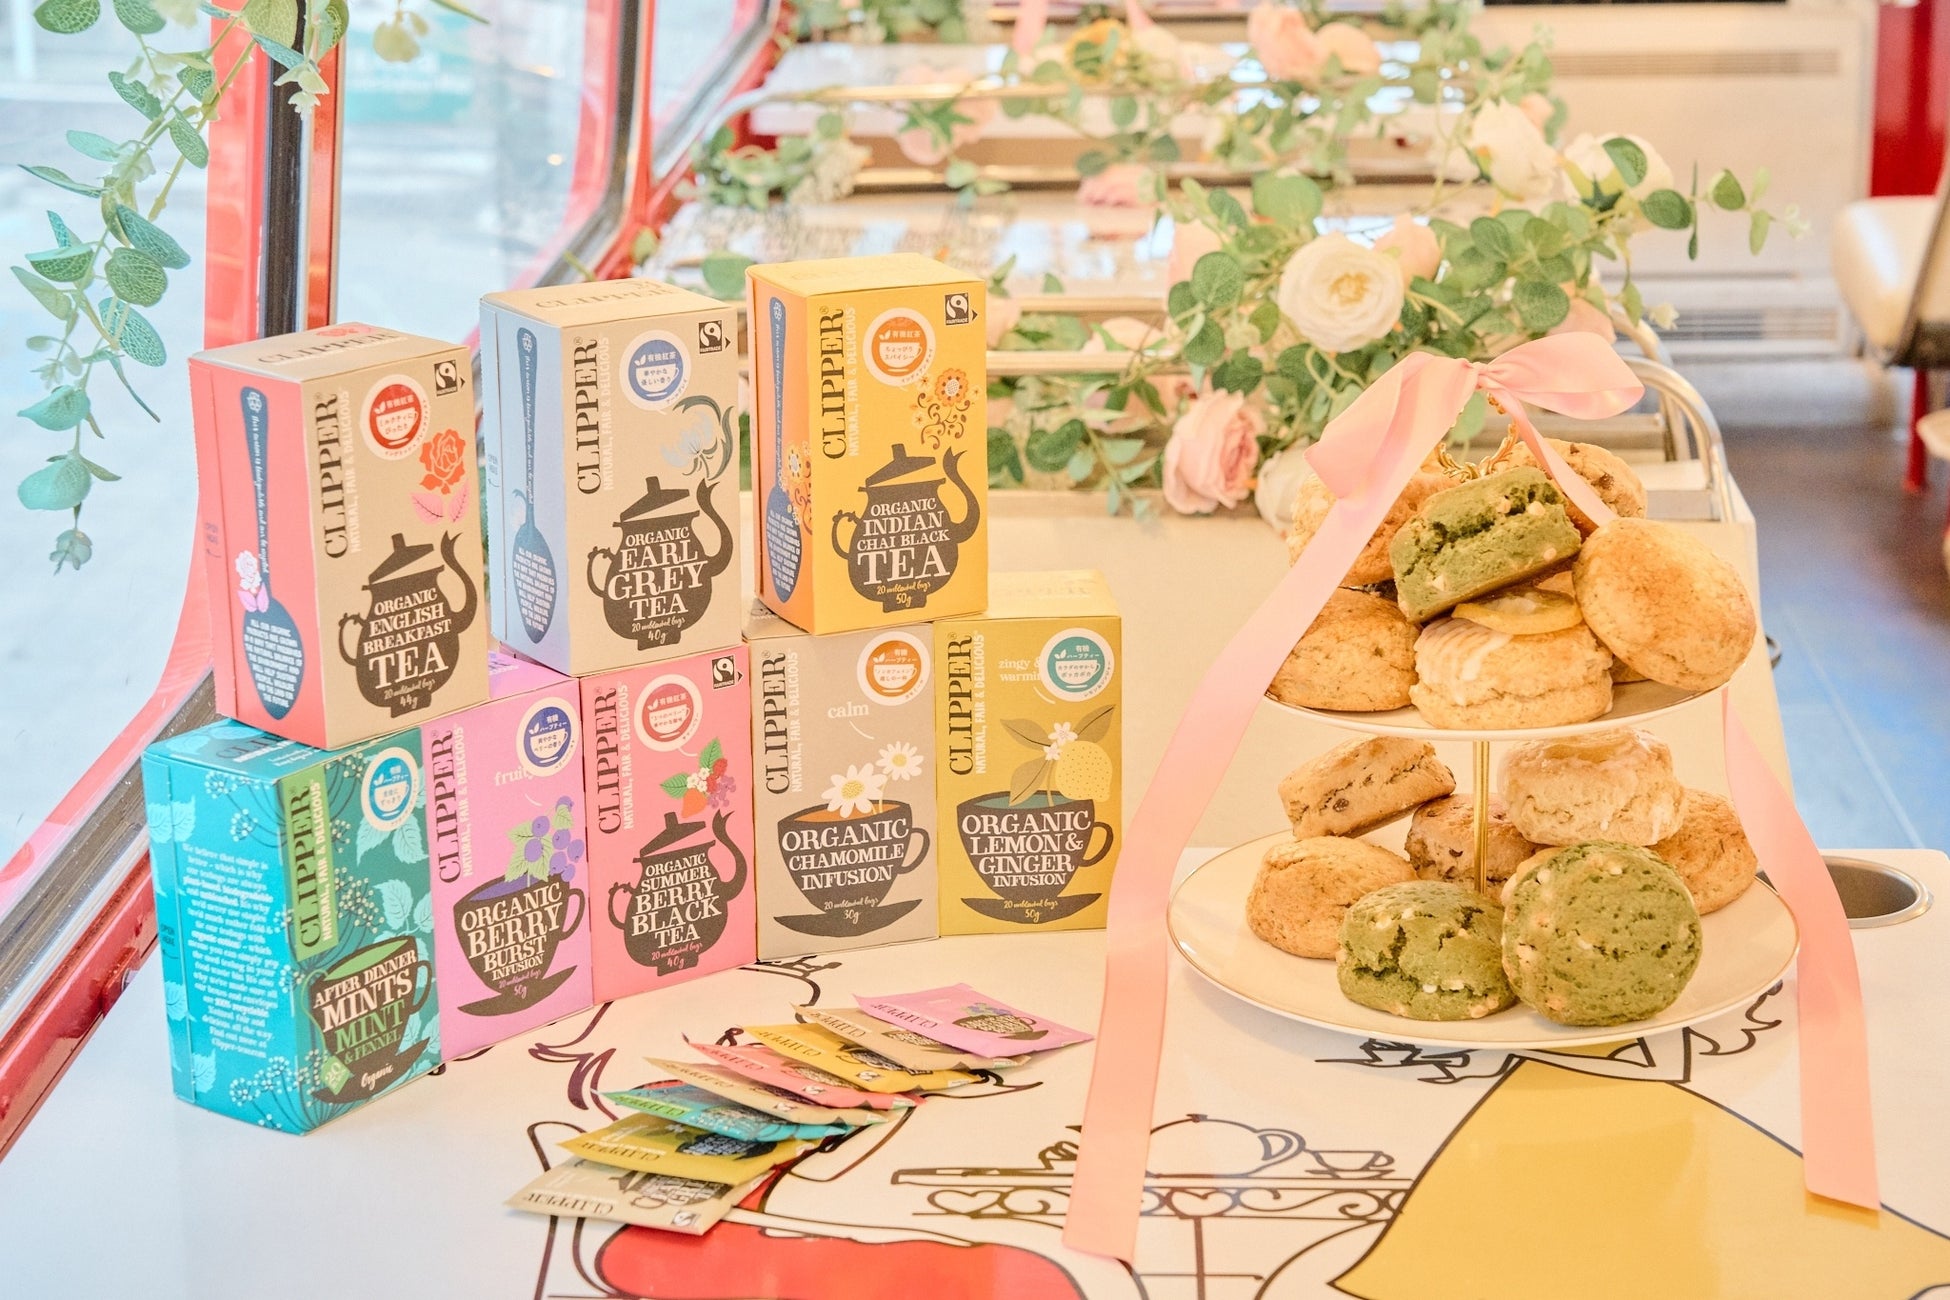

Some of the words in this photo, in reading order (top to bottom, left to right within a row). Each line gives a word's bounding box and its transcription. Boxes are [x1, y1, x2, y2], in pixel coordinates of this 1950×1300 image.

[846, 307, 856, 364] DELICIOUS
[599, 337, 610, 396] DELICIOUS
[648, 351, 676, 362] 有機紅茶
[848, 368, 856, 376] &
[848, 378, 858, 401] FAIR
[602, 398, 610, 407] &
[340, 389, 353, 452] DELICIOUS
[602, 410, 611, 434] FAIR
[345, 456, 354, 465] &
[345, 468, 356, 494] FAIR
[871, 498, 937, 516] ORGANIC
[863, 511, 944, 536] INDIAN
[626, 527, 690, 547] ORGANIC
[857, 536, 895, 551] CHAI
[901, 530, 950, 547] BLACK
[619, 540, 698, 572] EARL
[858, 545, 950, 585] TEA
[608, 560, 708, 601] GREY
[877, 585, 885, 595] 20
[917, 580, 930, 592] bags
[374, 588, 437, 616] ORGANIC
[630, 593, 688, 621] TEA
[896, 593, 912, 607] 50g
[369, 602, 445, 637] ENGLISH
[632, 623, 640, 633] 20
[671, 616, 685, 628] bags
[363, 619, 452, 655] BREAKFAST
[648, 629, 666, 644] 40g
[369, 642, 449, 689] TEA
[974, 634, 985, 688] DELICIOUS
[998, 659, 1031, 671] zingy
[788, 652, 799, 706] DELICIOUS
[975, 690, 984, 698] &
[618, 685, 630, 741] DELICIOUS
[789, 708, 799, 716] &
[828, 701, 869, 719] calm
[975, 701, 985, 723] FAIR
[790, 719, 801, 741] FAIR
[454, 726, 467, 785] DELICIOUS
[621, 743, 630, 751] &
[621, 753, 632, 777] FAIR
[458, 787, 468, 795] &
[310, 782, 325, 844] DELICIOUS
[460, 798, 470, 822] FAIR
[962, 810, 1091, 835] ORGANIC
[782, 818, 909, 852] ORGANIC
[970, 833, 1063, 855] LEMON
[1065, 833, 1083, 851] &
[317, 845, 326, 854] &
[789, 843, 904, 871] CHAMOMILE
[318, 858, 328, 883] FAIR
[646, 853, 706, 876] ORGANIC
[979, 854, 1074, 874] GINGER
[641, 866, 711, 893] SUMMER
[801, 865, 894, 891] INFUSION
[993, 873, 1066, 887] INFUSION
[461, 882, 562, 931] ORGANIC
[636, 877, 717, 914] BERRY
[824, 902, 833, 910] 20
[865, 896, 878, 907] bags
[1044, 899, 1058, 910] bags
[632, 896, 722, 936] BLACK
[844, 910, 860, 924] 30g
[1025, 910, 1040, 922] 50g
[468, 902, 562, 959] BERRY
[655, 924, 700, 948] TEA
[483, 935, 546, 973] BURST
[652, 952, 660, 960] 20
[313, 976, 361, 1009] AFTER
[364, 950, 417, 986] DINNER
[492, 954, 544, 980] INFUSION
[322, 968, 413, 1032] MINTS
[335, 999, 405, 1054] MINT
[871, 1002, 940, 1030] CLIPPER
[344, 1054, 353, 1064] &
[355, 1030, 400, 1061] FENNEL
[759, 1031, 821, 1057] CLIPPER
[361, 1064, 394, 1091] Organic
[524, 1192, 613, 1215] CLIPPER
